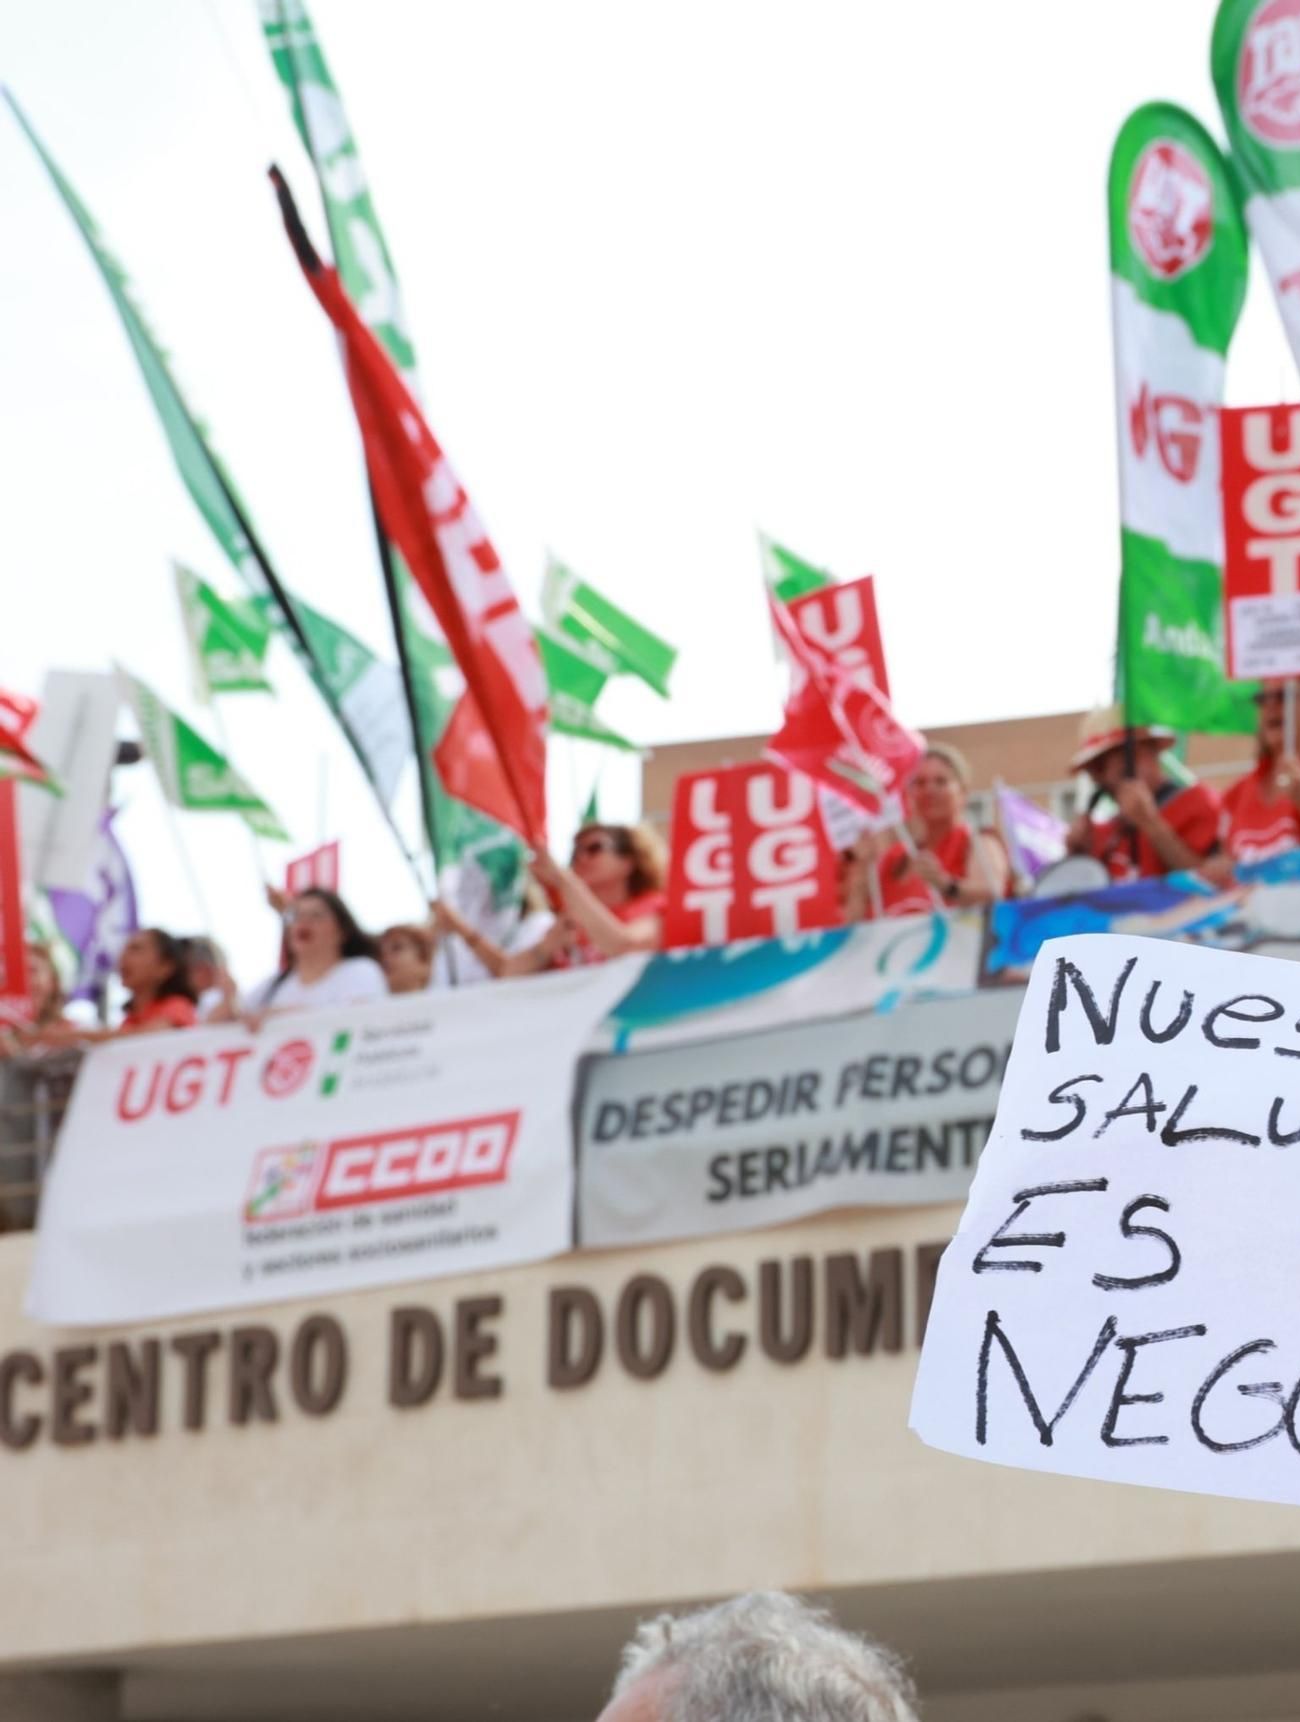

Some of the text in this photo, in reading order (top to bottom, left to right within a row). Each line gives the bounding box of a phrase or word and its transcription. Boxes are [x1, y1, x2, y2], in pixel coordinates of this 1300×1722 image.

[745, 773, 820, 940] UGT
[115, 1045, 255, 1124] UGT
[591, 1041, 1013, 1143] DESPEDIR PERSO
[322, 1121, 506, 1196] CCOO
[972, 1177, 1183, 1291] ES
[0, 1312, 350, 1453] CENTRO
[387, 1293, 505, 1412] DE
